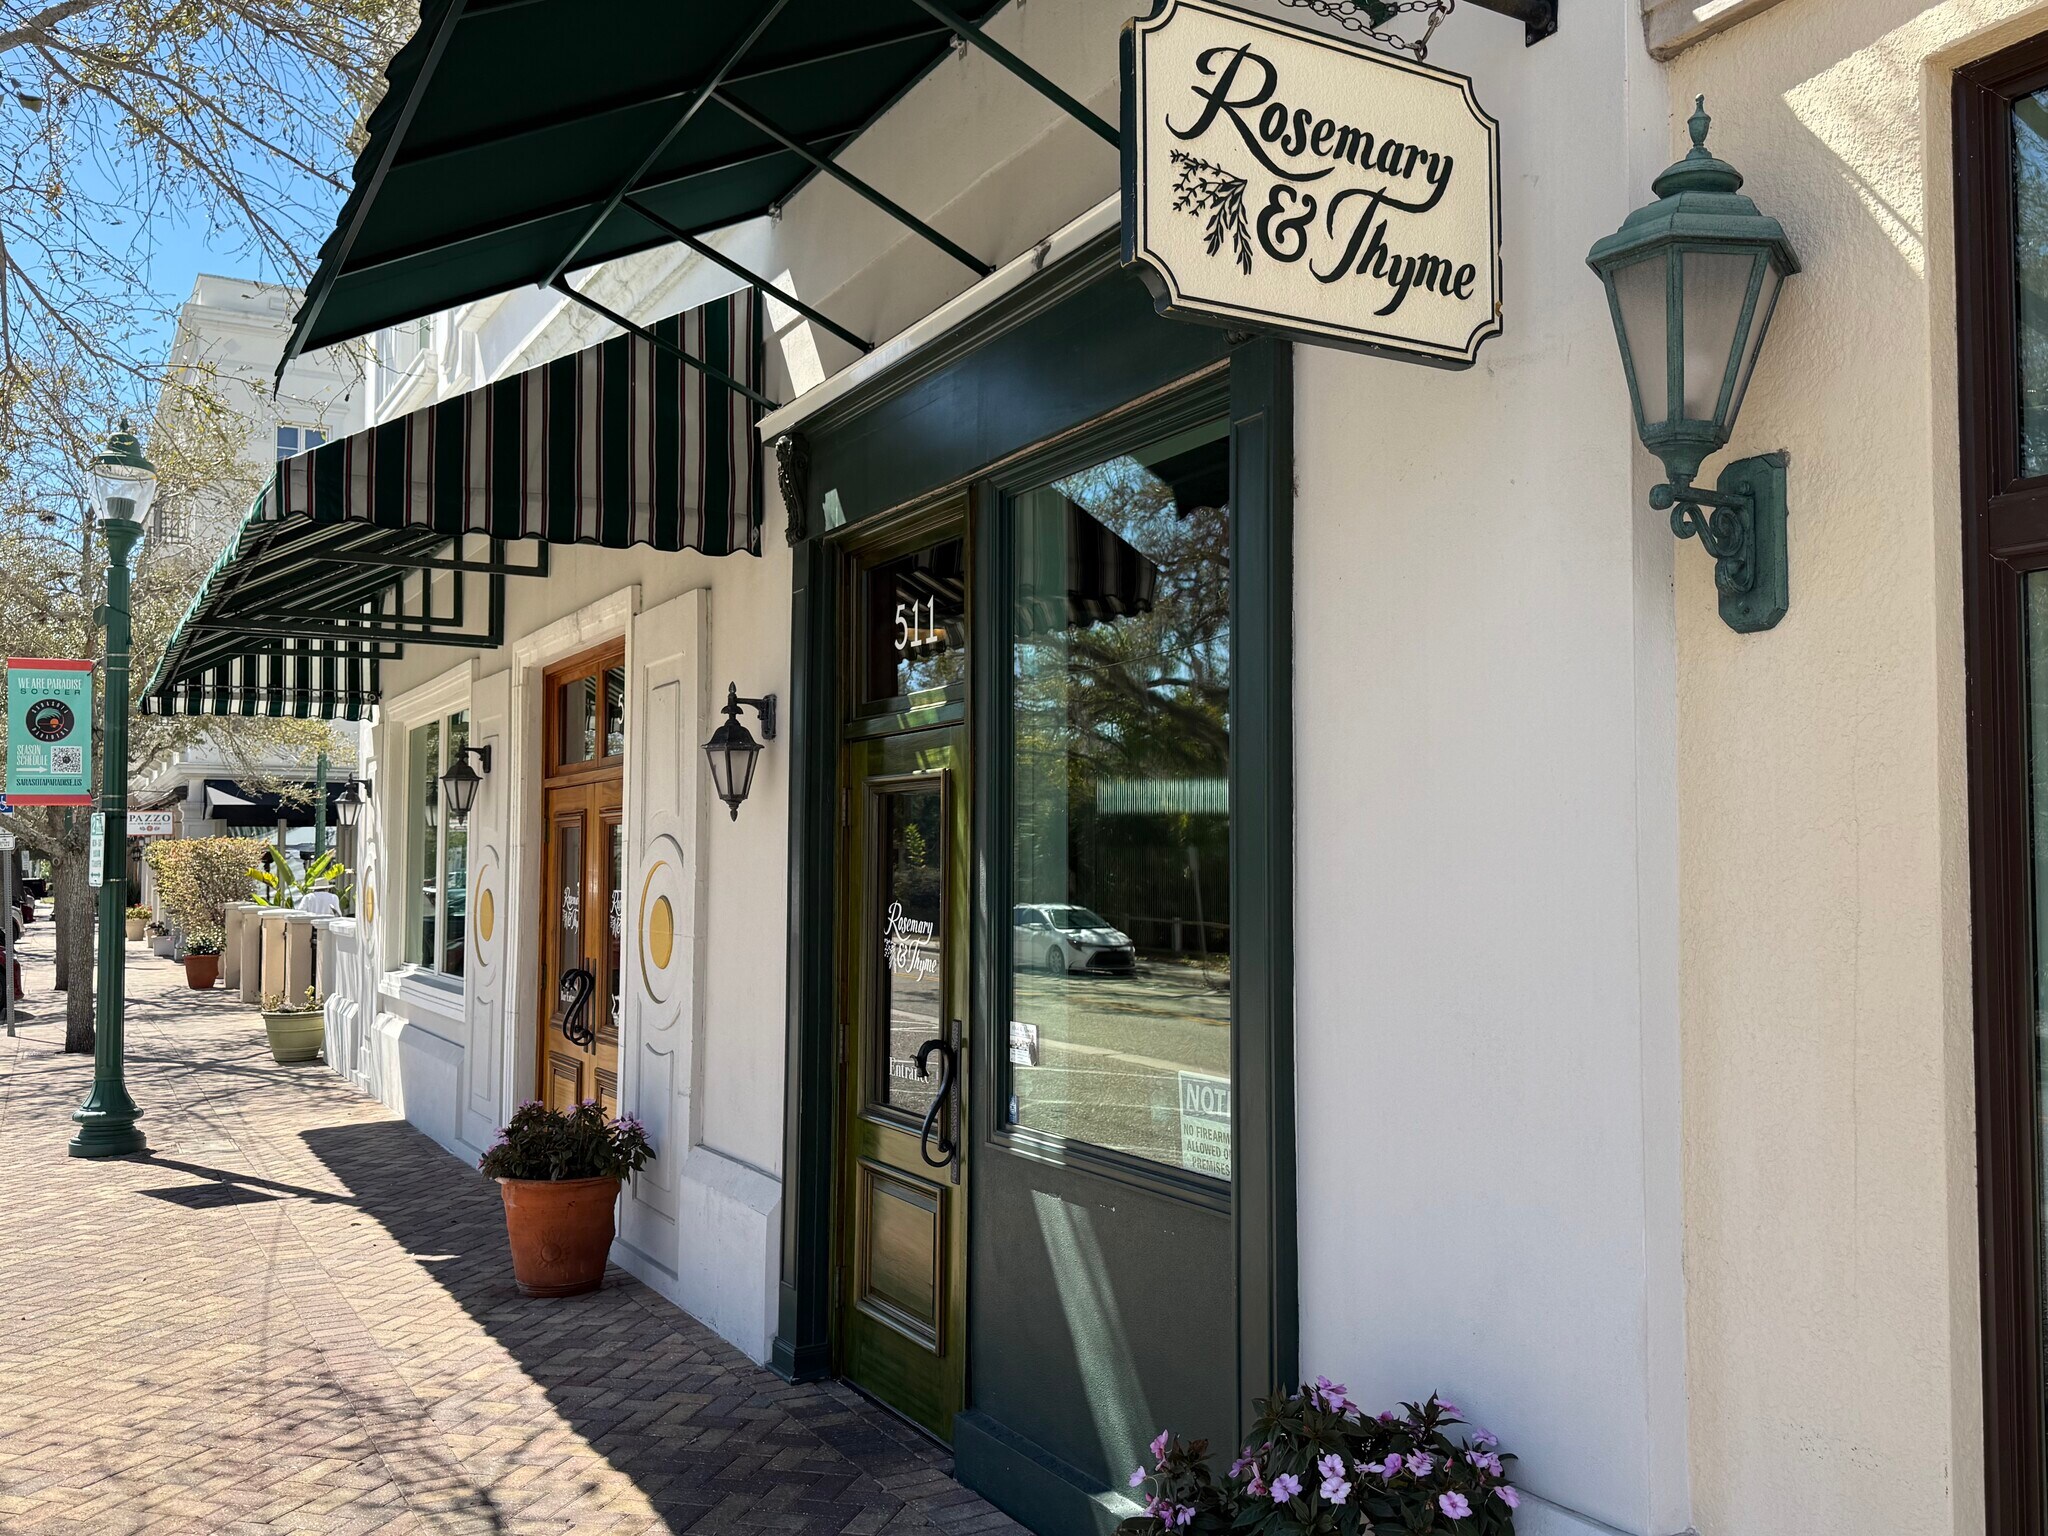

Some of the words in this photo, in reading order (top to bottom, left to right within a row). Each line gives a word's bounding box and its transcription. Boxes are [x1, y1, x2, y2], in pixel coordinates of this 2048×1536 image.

[1165, 42, 1454, 214] Rosemary
[1256, 184, 1317, 262] &
[1309, 187, 1476, 315] Thyme
[894, 594, 938, 651] 511
[18, 677, 30, 689] WE
[31, 678, 46, 689] ARE
[47, 678, 82, 690] PARADISE
[20, 688, 81, 696] SOCCER
[16, 744, 41, 755] SEASON
[16, 755, 48, 766] SCHEDULE
[16, 778, 83, 787] SARASOTAPARADISE.US
[129, 814, 171, 822] PAZZO
[884, 900, 934, 945] Rosemary
[897, 943, 908, 968] &
[905, 938, 937, 982] Thyme
[1183, 1123, 1194, 1136] NO
[1187, 1139, 1221, 1158] ALLOWED
[1192, 1156, 1231, 1177] PREMISES
